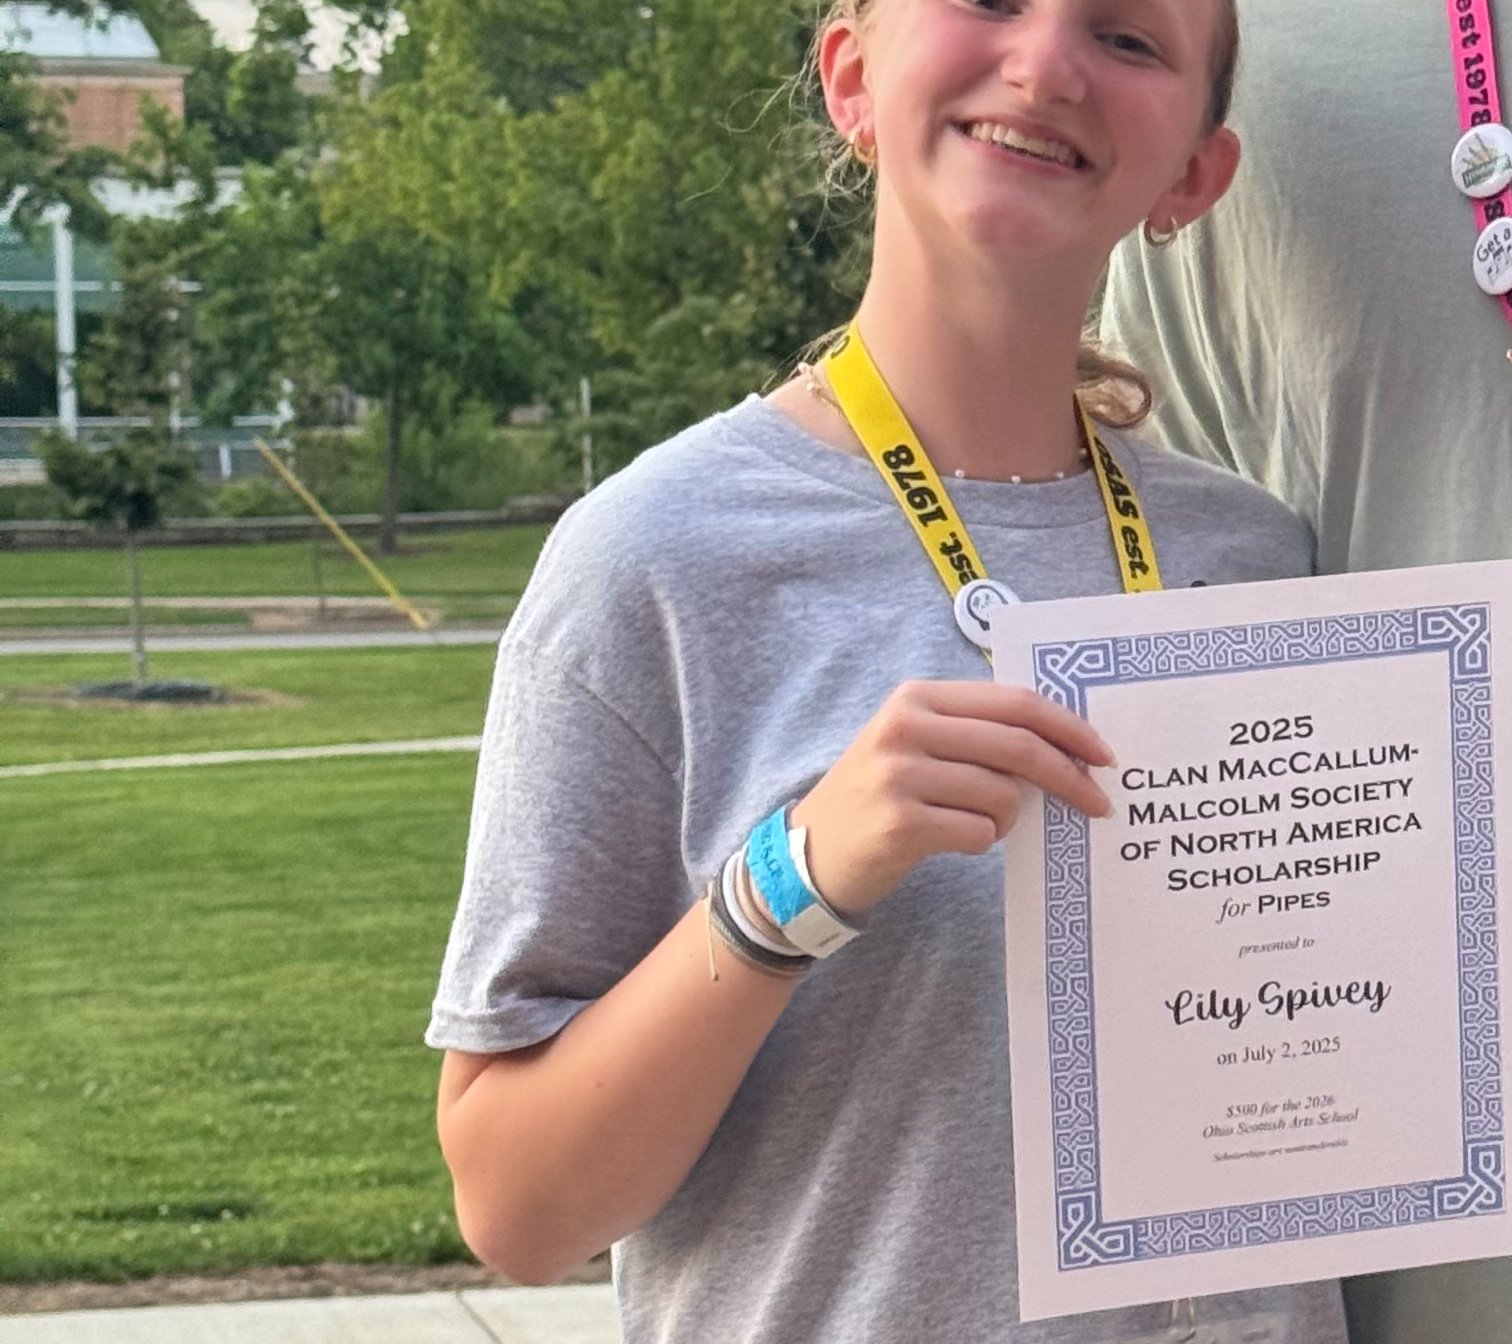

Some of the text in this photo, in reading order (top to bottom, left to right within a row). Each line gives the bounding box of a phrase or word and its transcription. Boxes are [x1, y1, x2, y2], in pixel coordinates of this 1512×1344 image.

[1464, 53, 1492, 127] 1978
[1477, 234, 1502, 262] Get
[882, 444, 948, 527] 1978
[1121, 525, 1150, 580] est
[1229, 715, 1315, 746] 2025
[1121, 764, 1209, 791] CLAN
[1128, 777, 1414, 826] MALCOLM SOCIETY
[1120, 812, 1423, 861] OF NORTH AMERICA
[1167, 851, 1382, 892] SCHOLARSHIP
[1215, 891, 1331, 924] for PIPES
[1238, 936, 1315, 958] presented to
[1164, 980, 1392, 1030] Lily Spivey
[1217, 1036, 1341, 1066] on July 2, 2025
[1259, 1102, 1279, 1117] for
[1282, 1098, 1302, 1112] the
